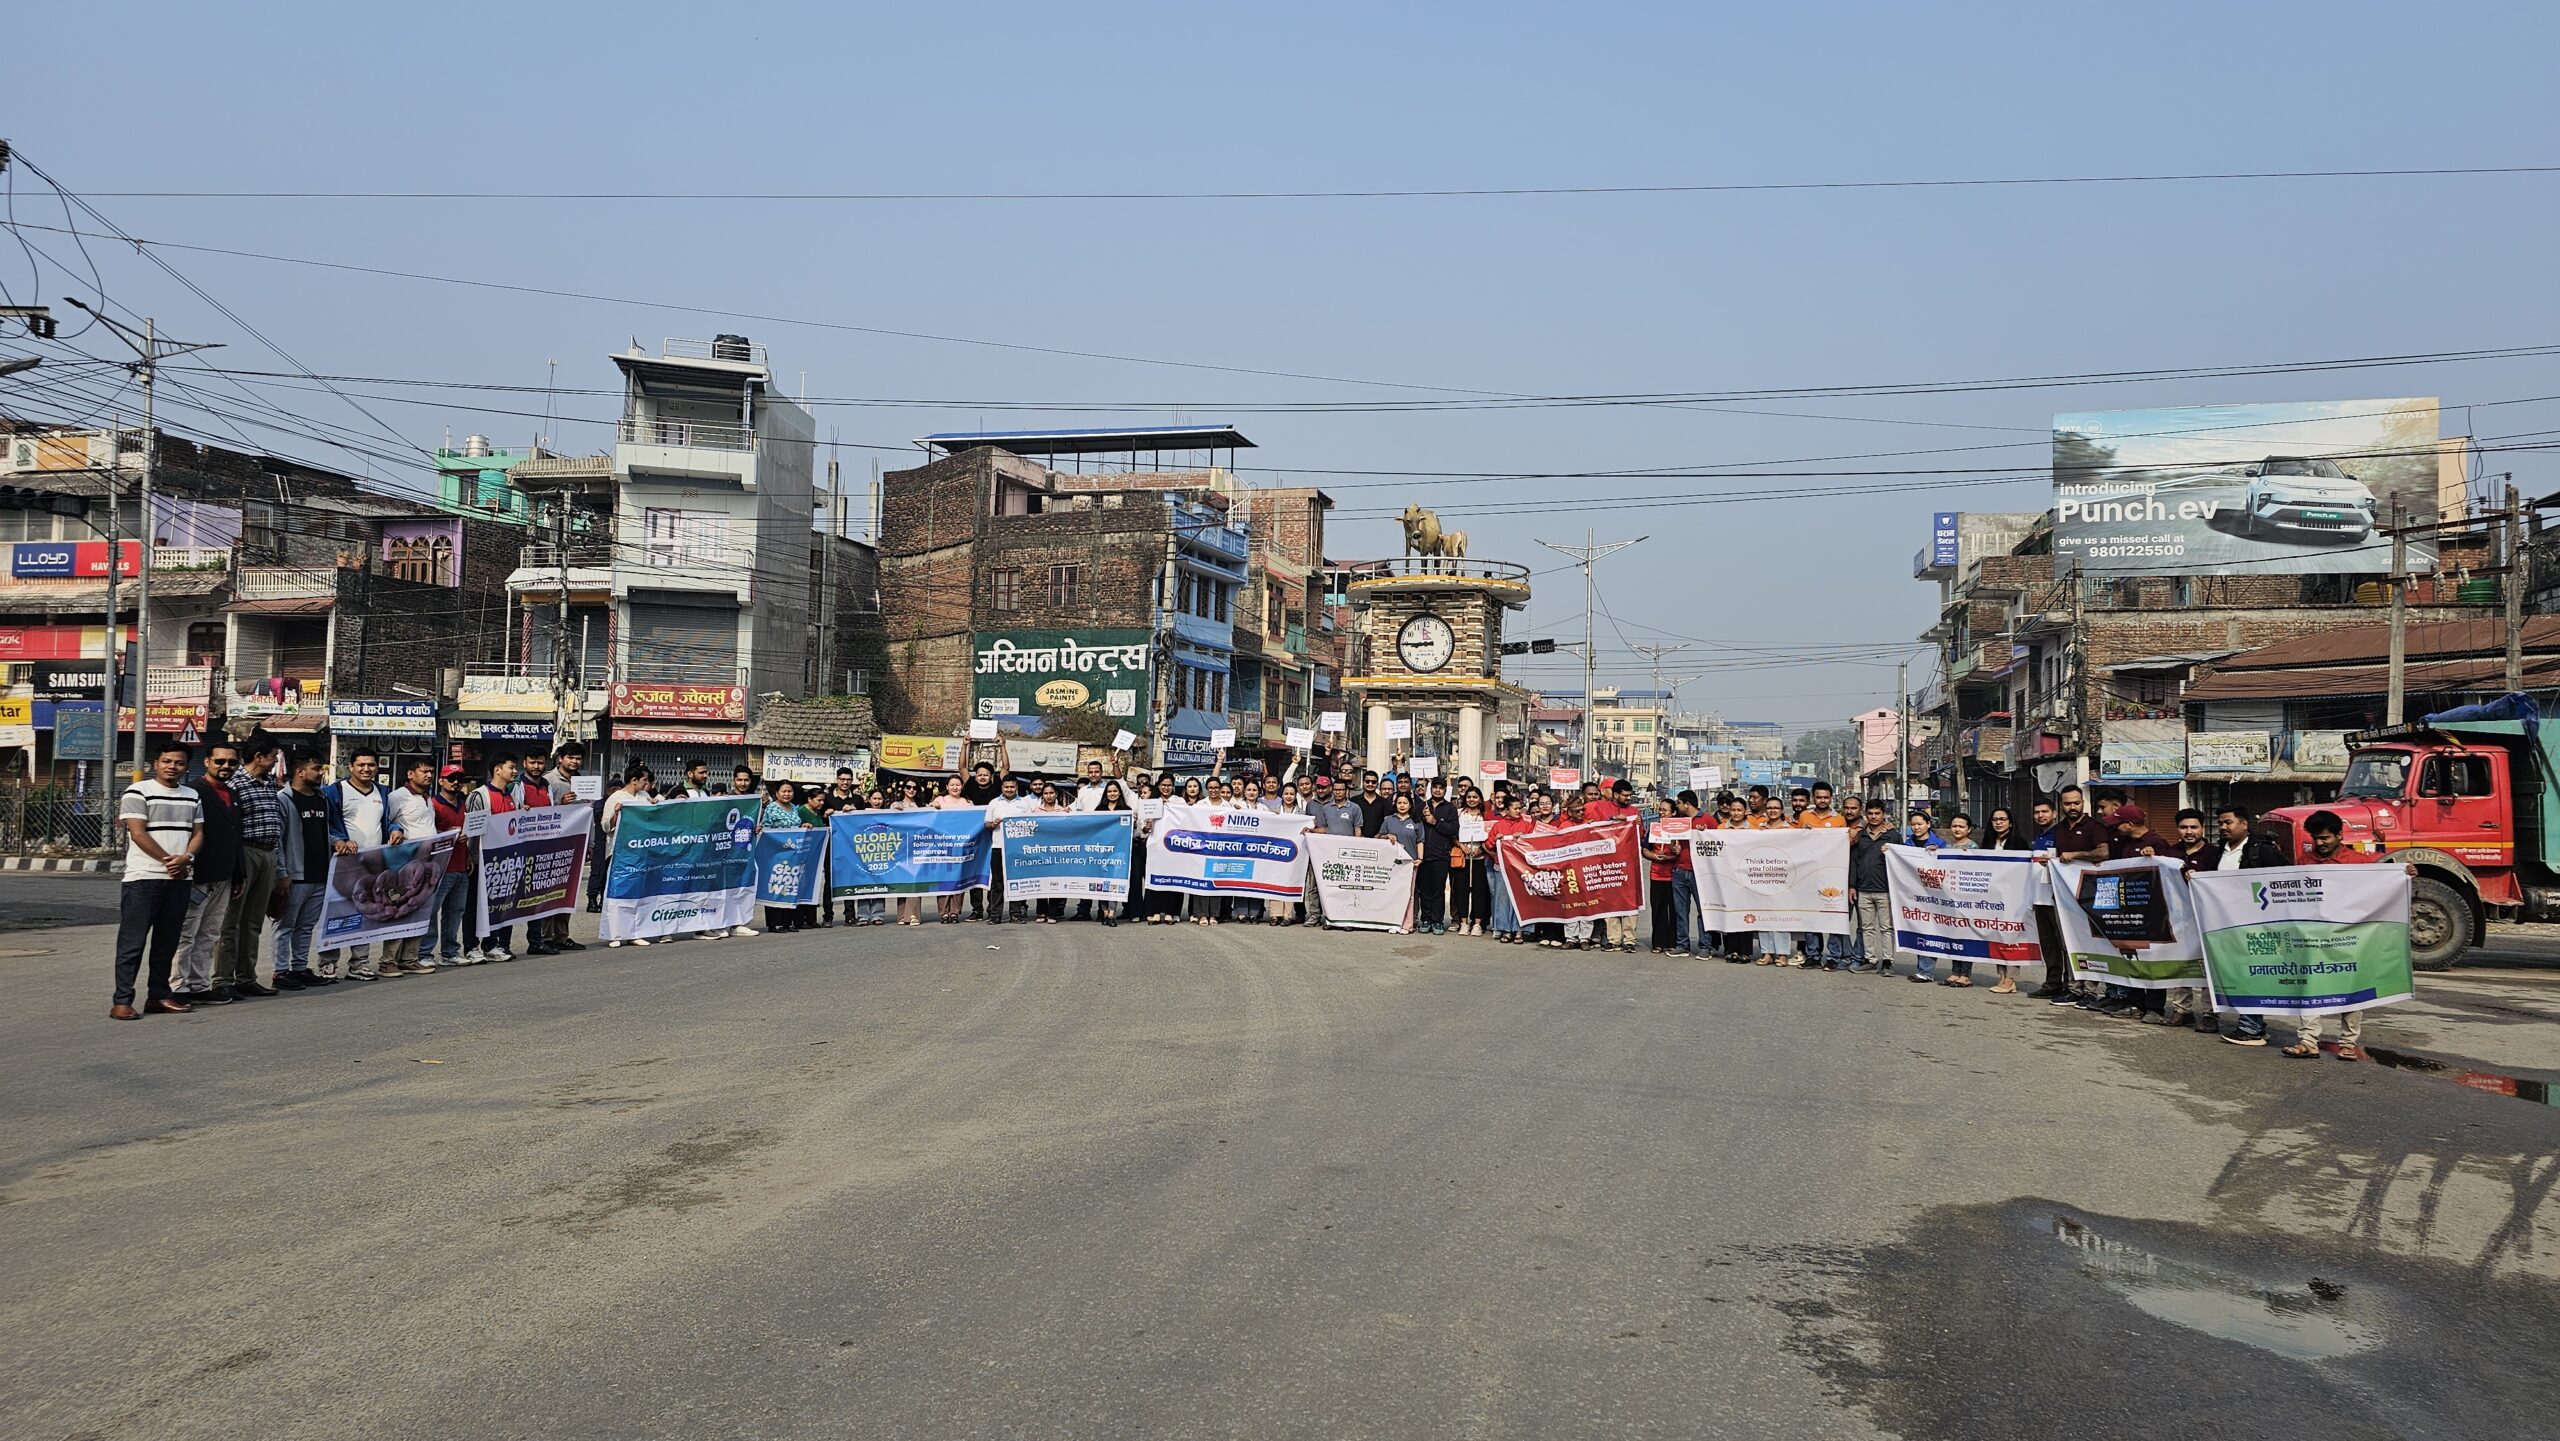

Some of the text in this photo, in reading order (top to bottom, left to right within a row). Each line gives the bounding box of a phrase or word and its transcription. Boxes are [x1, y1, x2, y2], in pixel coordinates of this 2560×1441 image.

[2059, 481, 2156, 496] introducing
[2058, 497, 2219, 523] Punch.ev
[2059, 536, 2081, 546] give
[2084, 537, 2097, 545] us
[2110, 534, 2148, 544] missed
[2151, 534, 2171, 543] call
[2173, 534, 2185, 543] at
[2089, 545, 2185, 557] 9801225500
[18, 552, 69, 565] LLOYD
[49, 672, 117, 688] SAMSUN
[1227, 814, 1260, 827] NIMB
[628, 837, 669, 849] GLOBAL
[671, 834, 711, 845] MONEY
[711, 831, 732, 841] WEEK
[853, 832, 903, 843] GLOBAL
[715, 841, 732, 851] 2025
[855, 842, 902, 854] MONEY
[1084, 842, 1115, 854] कार्यक्रम
[1205, 839, 1243, 852] साक्षरता
[1246, 841, 1291, 857] कार्यक्रम
[536, 853, 554, 862] THINK
[861, 852, 896, 863] WEEK
[1014, 856, 1122, 867] Financial Literacy Program
[868, 863, 889, 871] 2025
[1583, 865, 1602, 873] think
[1566, 869, 1580, 894] 2025
[1584, 872, 1598, 880] you
[1585, 875, 1628, 886] wise money
[1586, 882, 1622, 892] tomorrow
[2269, 876, 2323, 890] कामना सेवा
[652, 907, 699, 921] Citizens
[1974, 917, 2026, 932] कार्यक्रम
